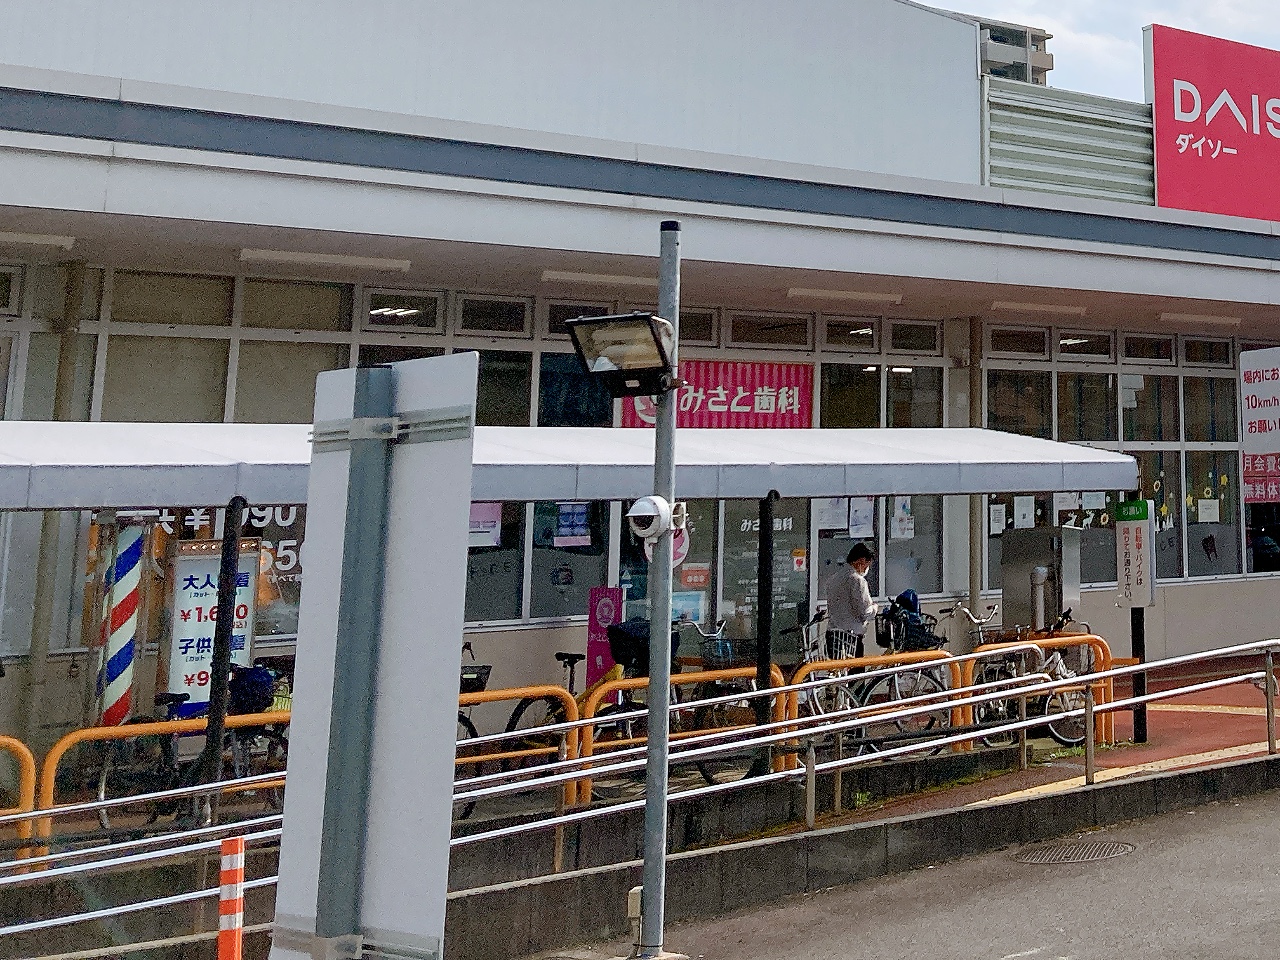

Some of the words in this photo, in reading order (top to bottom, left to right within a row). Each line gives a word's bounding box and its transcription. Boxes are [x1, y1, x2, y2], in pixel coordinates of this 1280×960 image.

[1175, 133, 1238, 160] ダイソー
[679, 385, 801, 415] みさと歯科
